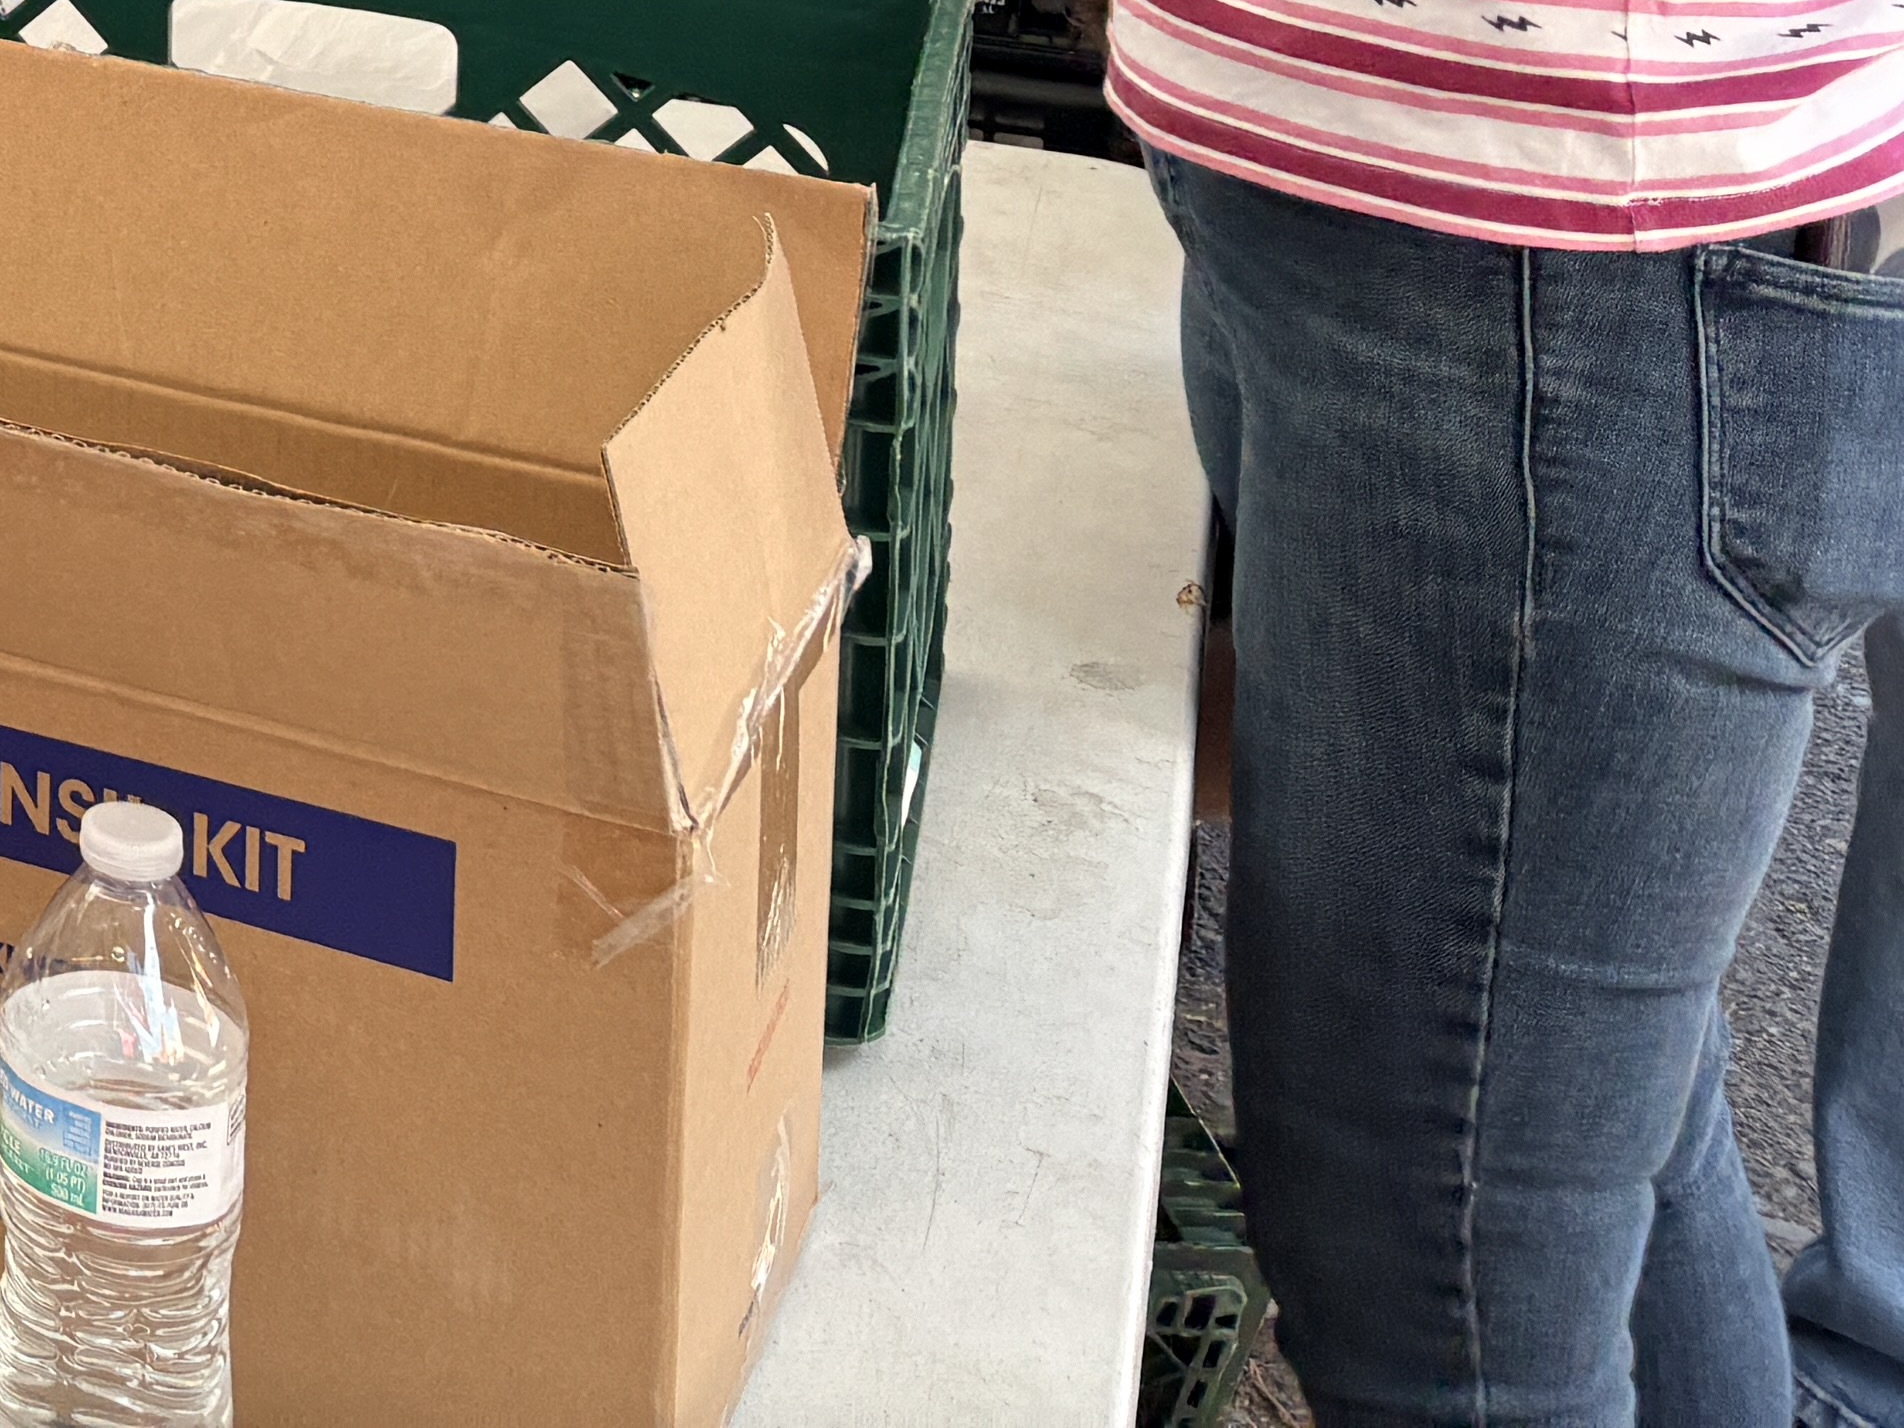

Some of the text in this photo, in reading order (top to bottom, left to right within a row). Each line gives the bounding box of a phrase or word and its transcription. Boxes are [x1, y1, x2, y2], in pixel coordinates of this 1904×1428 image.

[192, 811, 308, 903] KIT
[9, 1088, 56, 1125] WATER
[39, 1148, 60, 1168] 16.9
[74, 1163, 88, 1178] OZ
